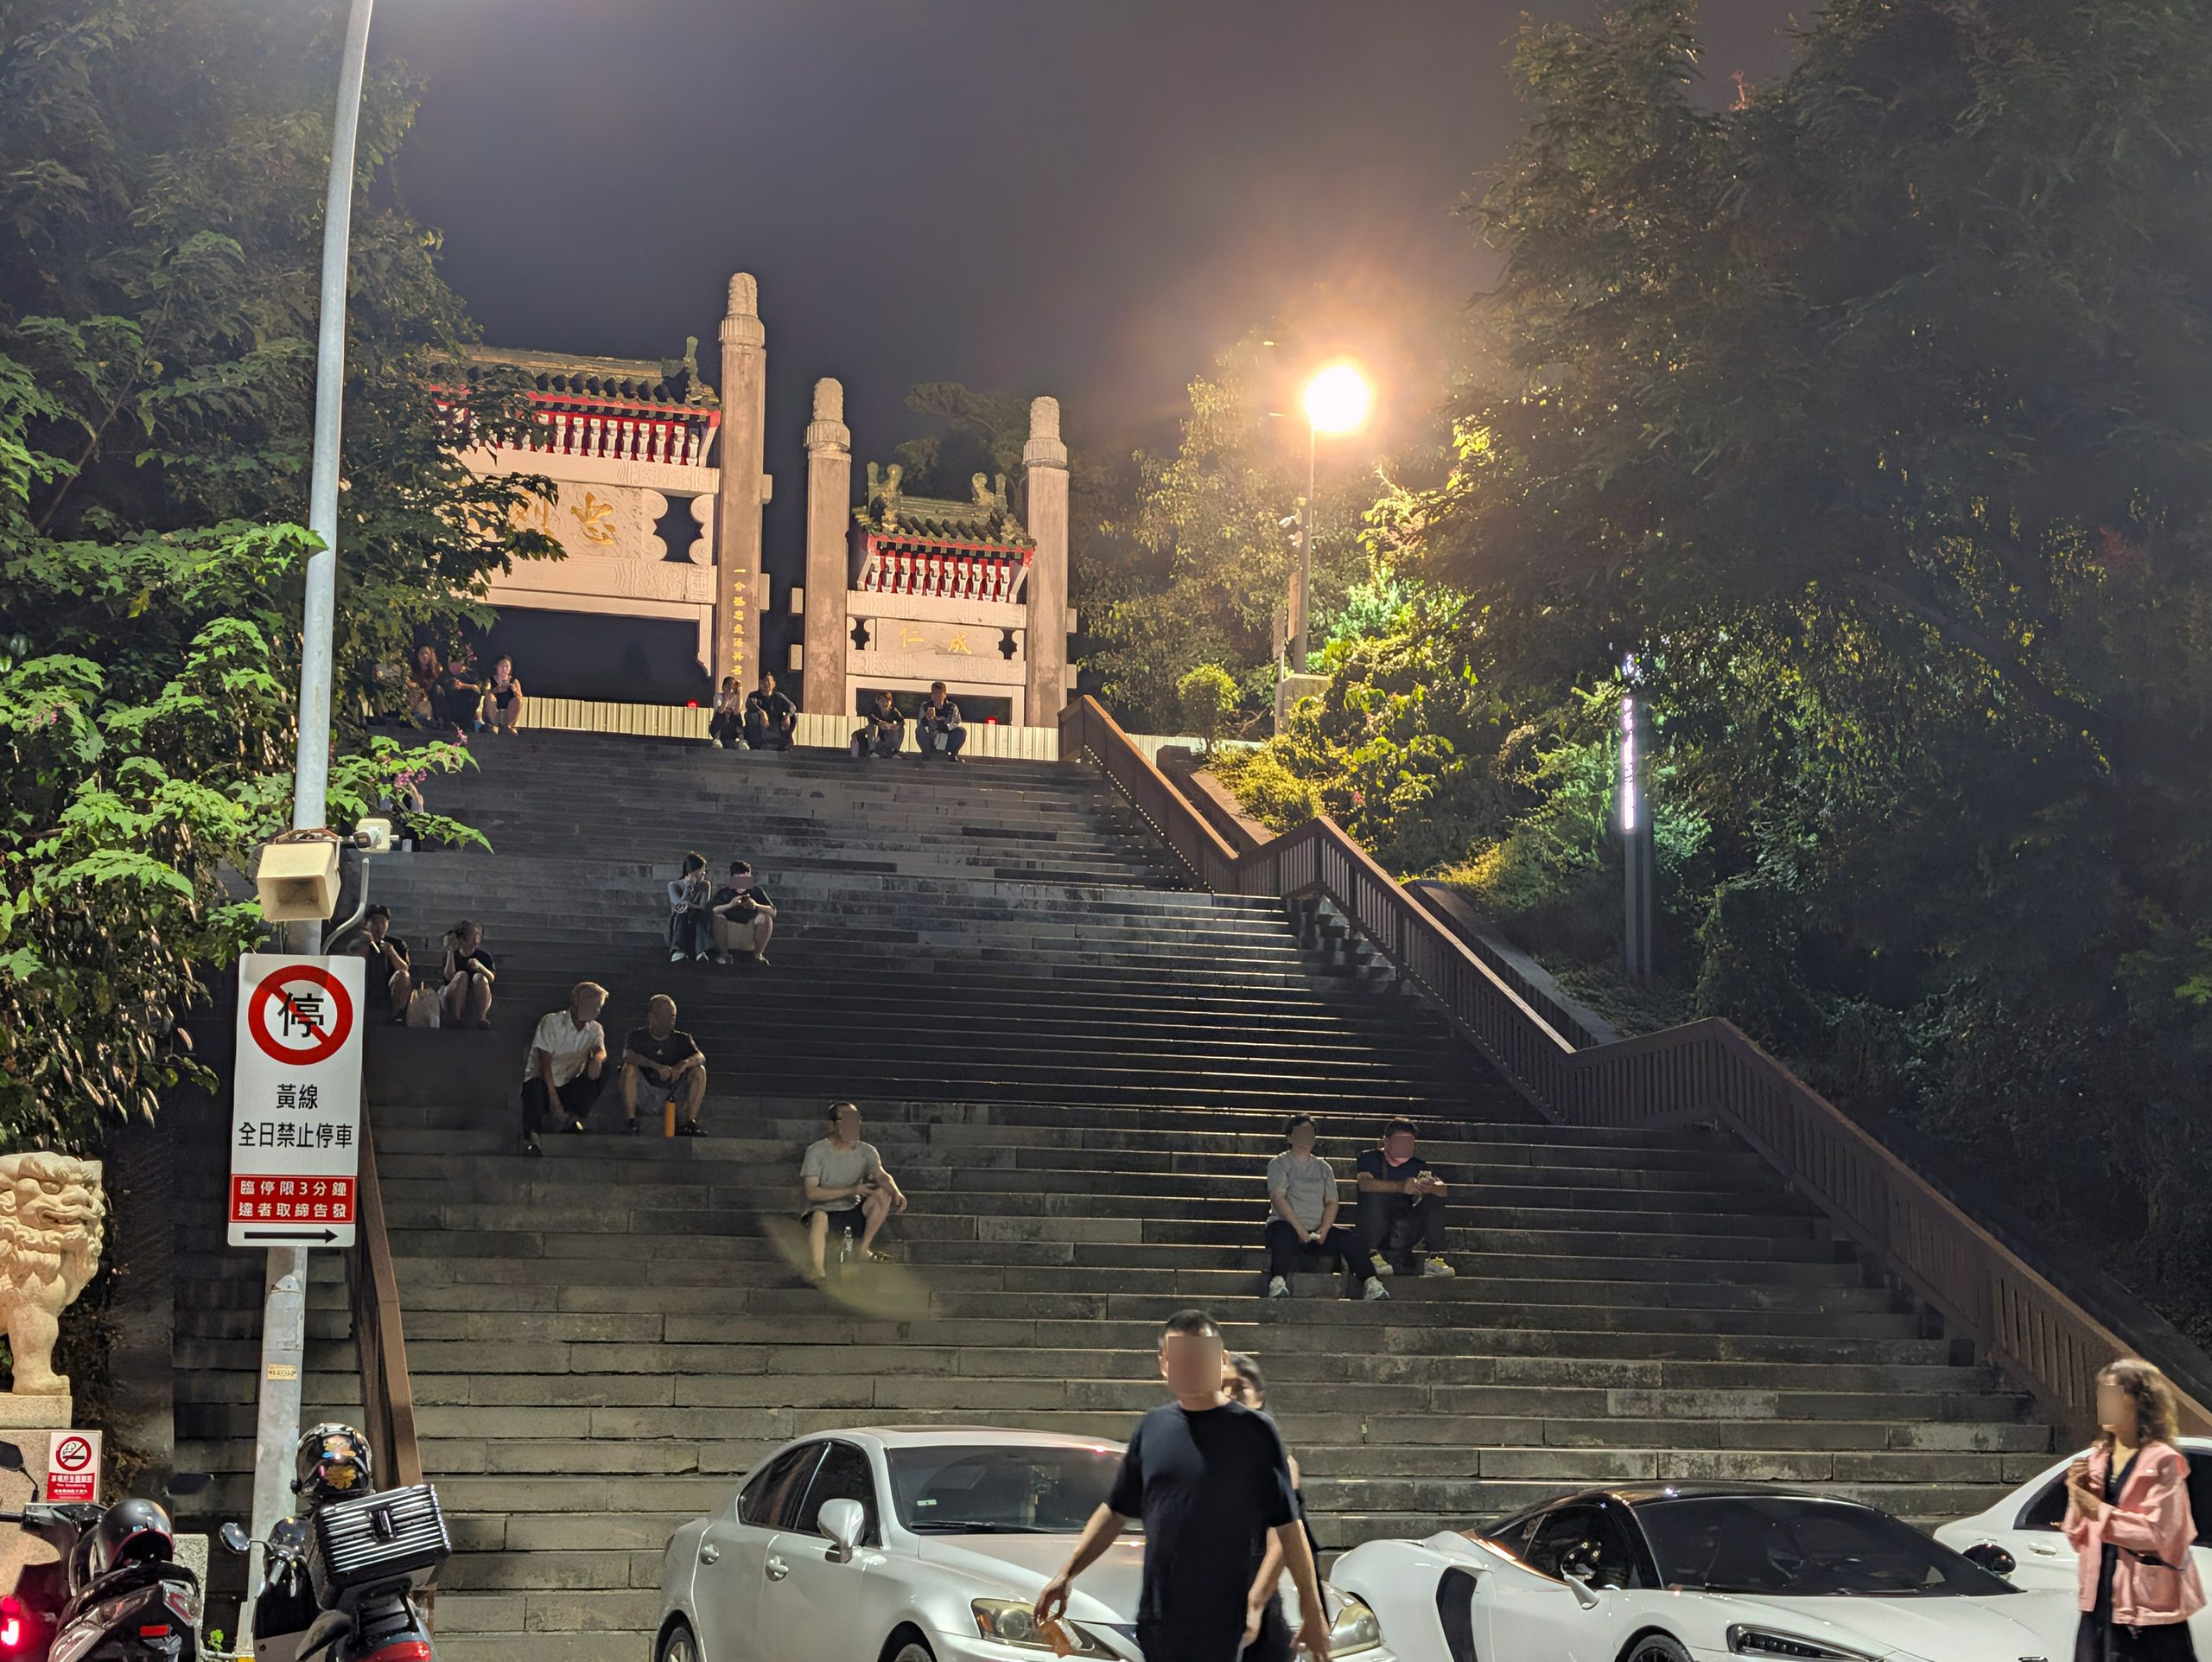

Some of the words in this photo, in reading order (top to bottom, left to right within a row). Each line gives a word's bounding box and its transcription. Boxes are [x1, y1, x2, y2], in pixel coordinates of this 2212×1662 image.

[277, 992, 324, 1037] 停
[276, 1083, 319, 1110] 黃線
[238, 1121, 353, 1149] 全日禁止停車
[240, 1180, 346, 1196] 臨停限3分鐘
[238, 1201, 346, 1218] 違者取締告發
